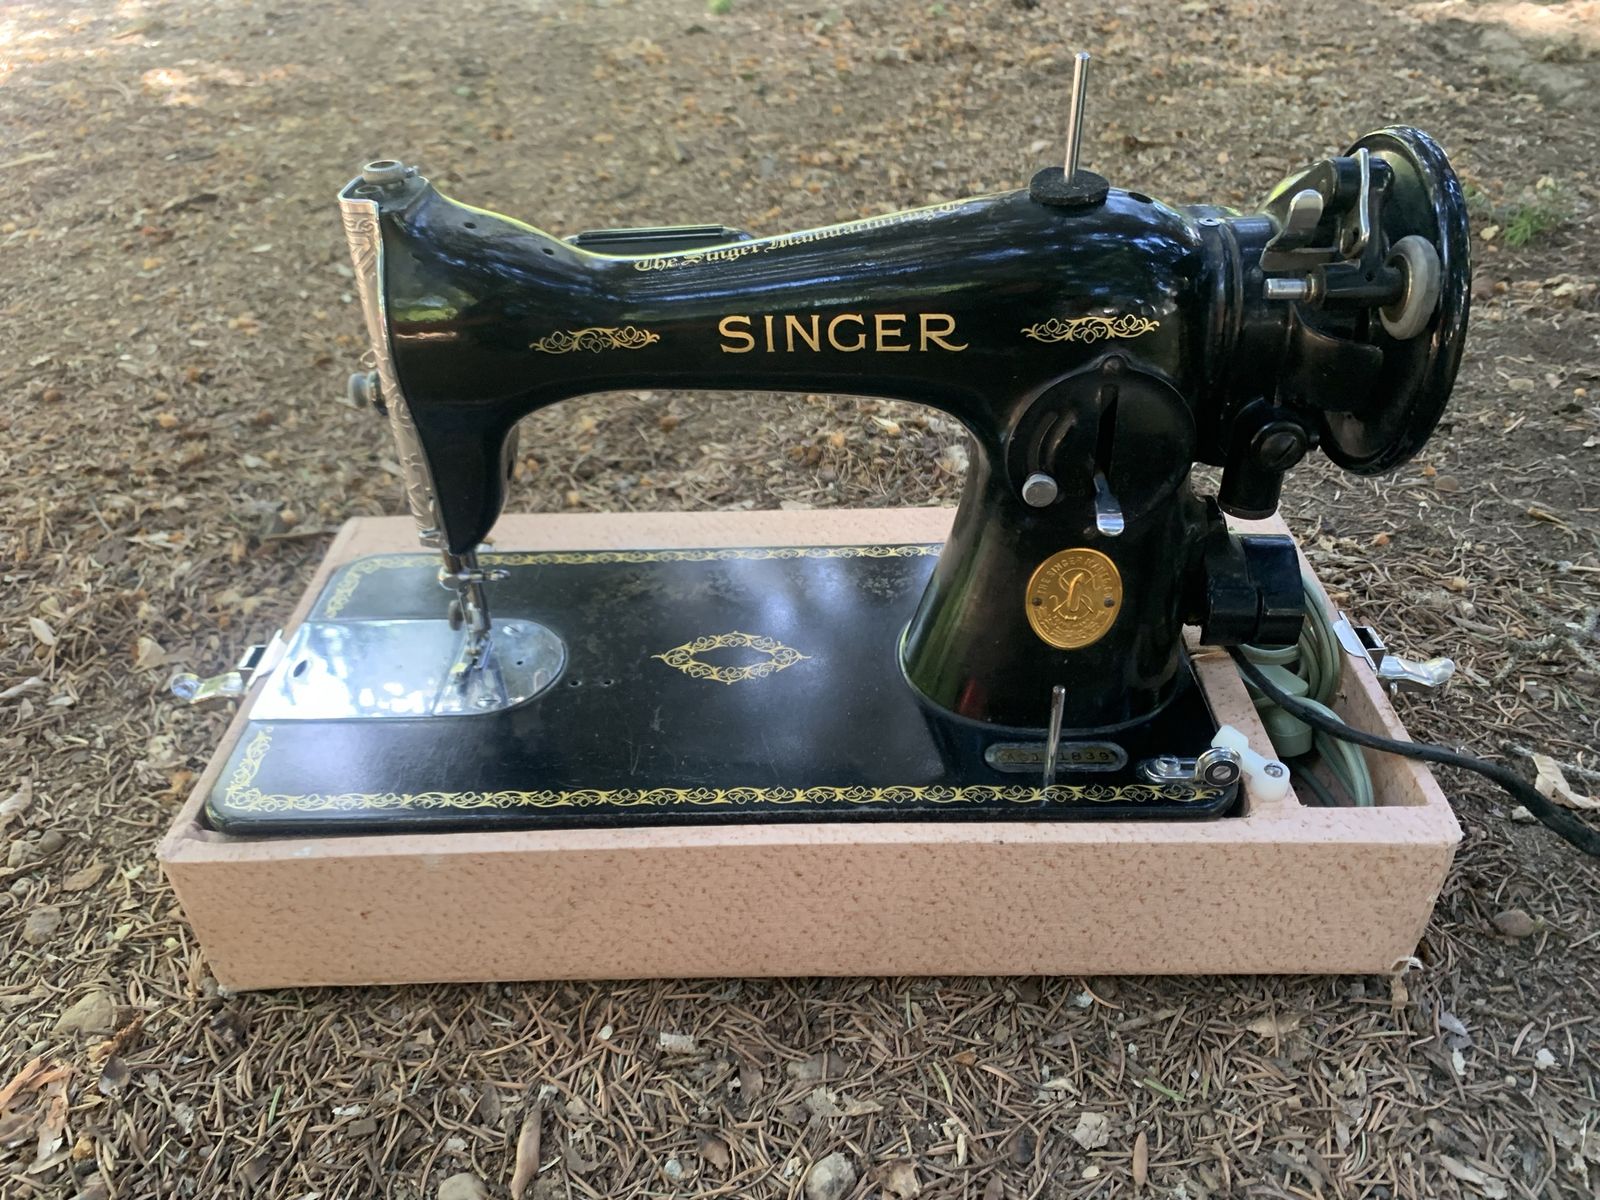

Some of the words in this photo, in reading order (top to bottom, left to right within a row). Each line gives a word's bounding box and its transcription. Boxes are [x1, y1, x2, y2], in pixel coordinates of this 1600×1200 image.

[633, 257, 677, 272] The
[681, 243, 764, 266] Singer
[718, 313, 969, 353] SINGER
